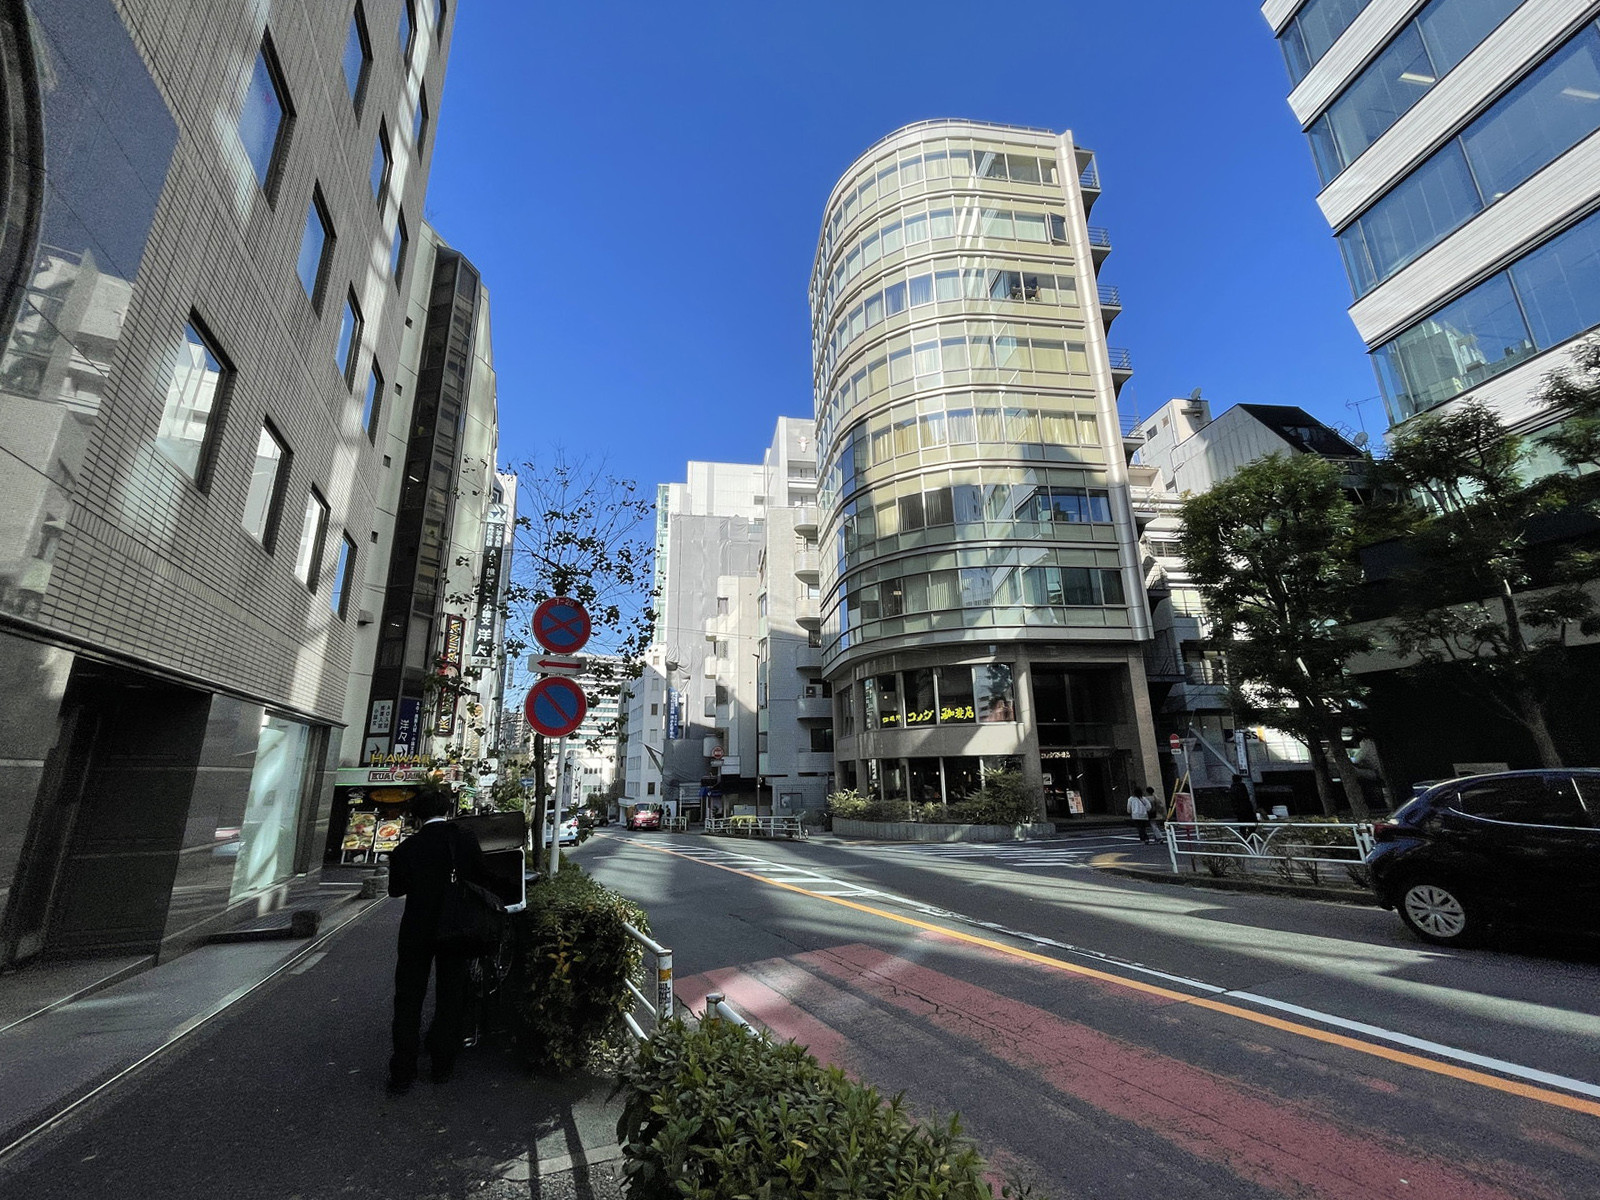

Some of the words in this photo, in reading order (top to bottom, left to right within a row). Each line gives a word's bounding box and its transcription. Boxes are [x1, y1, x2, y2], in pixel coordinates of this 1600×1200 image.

[555, 598, 575, 607] 7-20
[447, 622, 460, 664] AINA
[475, 628, 492, 657] 洋々
[940, 706, 975, 720] 珈琲店
[398, 719, 410, 741] 洋々
